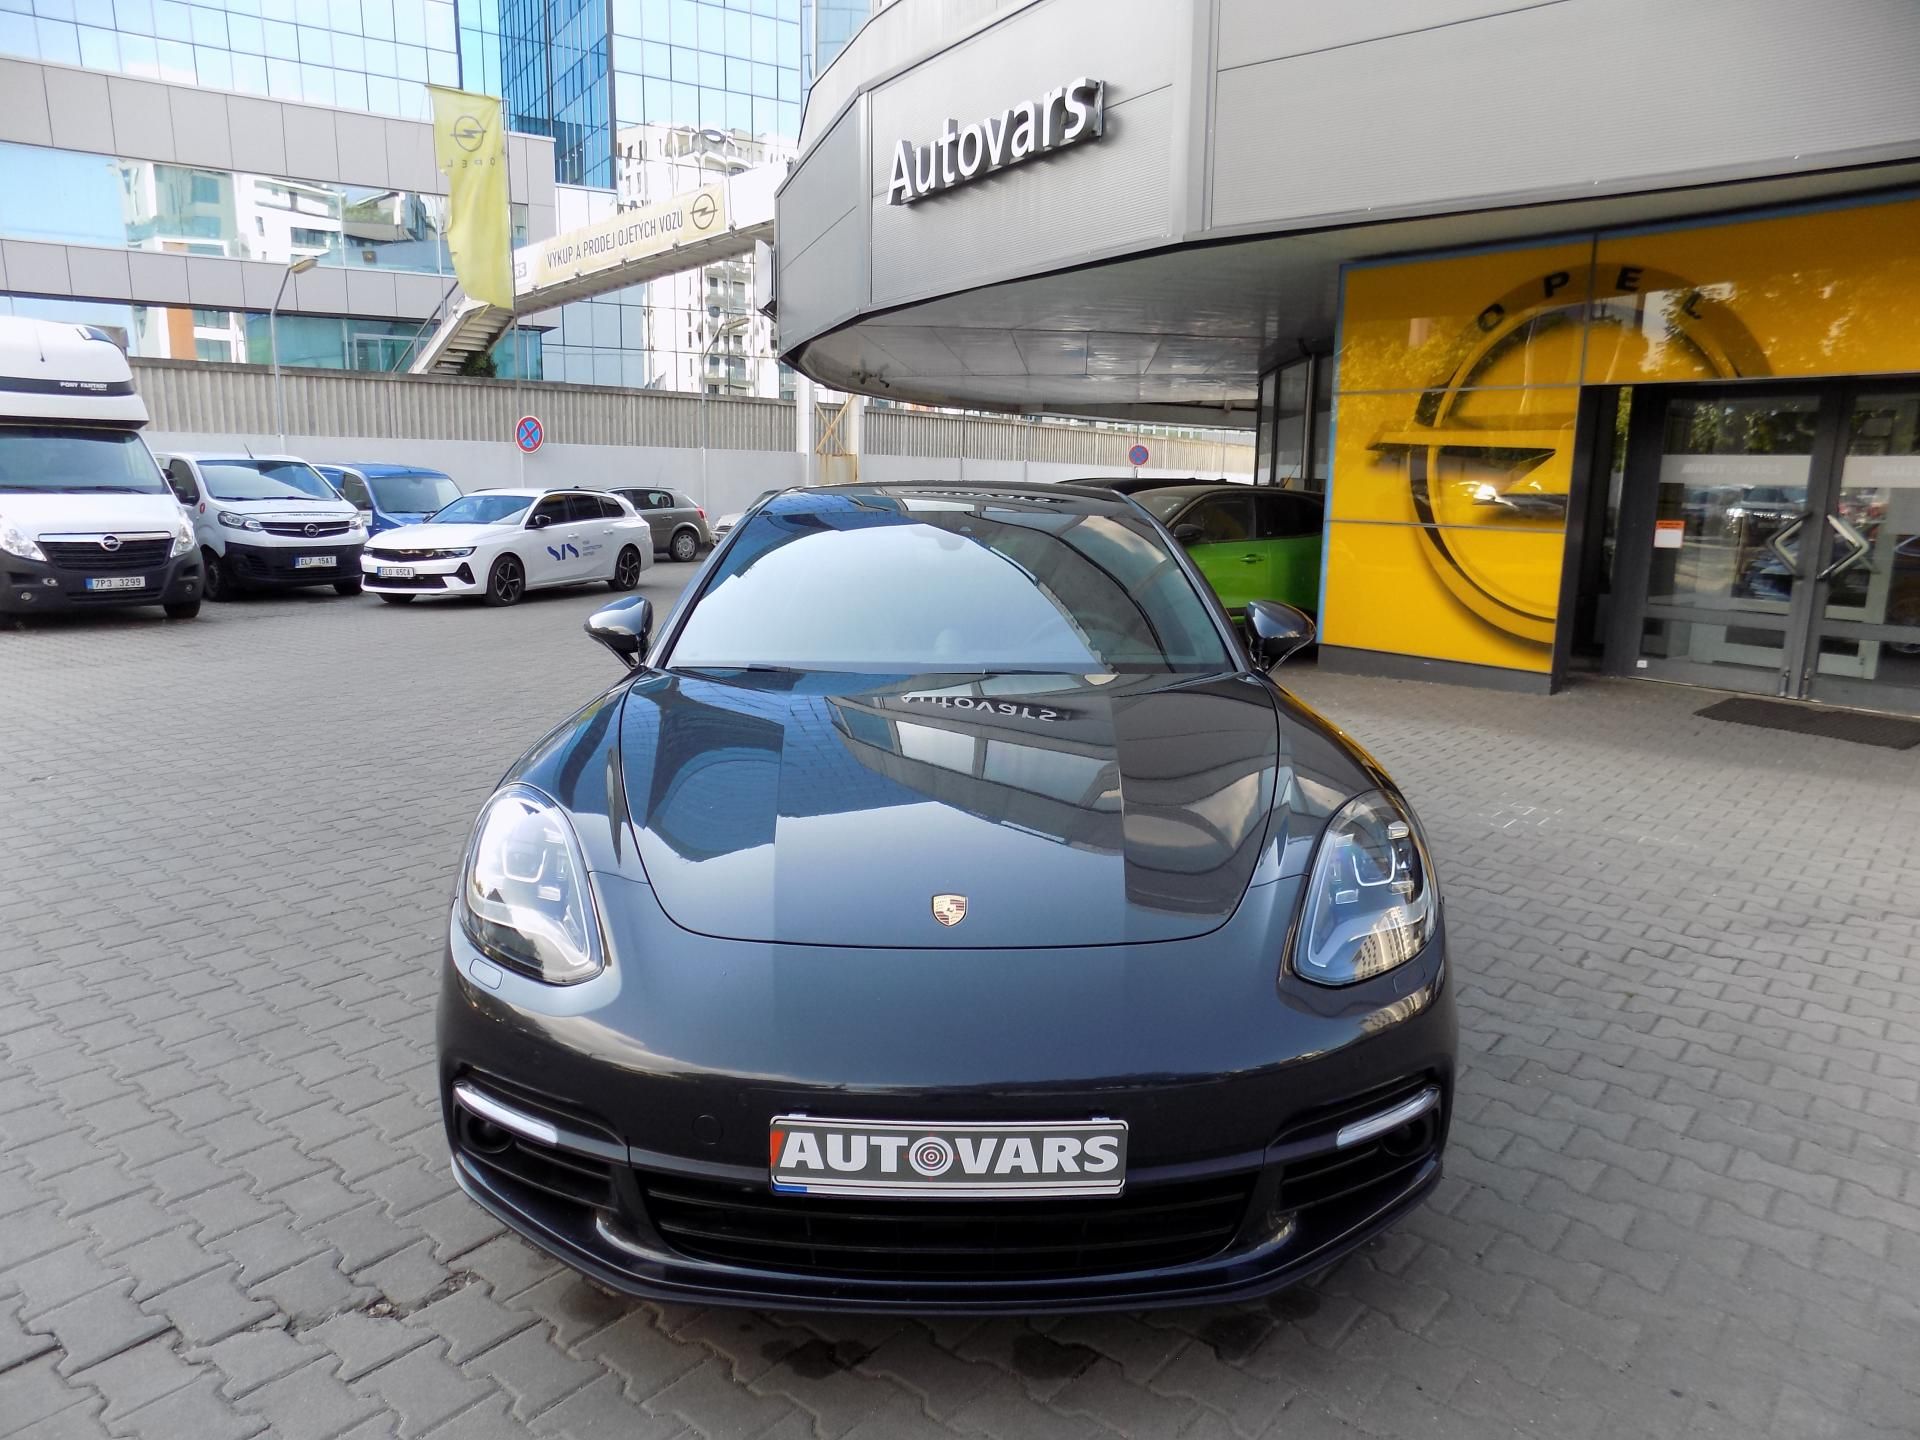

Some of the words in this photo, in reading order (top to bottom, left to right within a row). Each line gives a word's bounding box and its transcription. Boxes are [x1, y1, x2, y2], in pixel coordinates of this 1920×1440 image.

[887, 77, 1098, 206] Autovars
[575, 243, 582, 261] A
[583, 231, 615, 258] PRODEJ
[618, 217, 656, 248] OJETÝCH
[1477, 266, 1704, 333] OPEL
[95, 579, 112, 588] 7P3
[119, 577, 141, 587] 3299
[779, 1131, 1119, 1176] AUTOVARS
